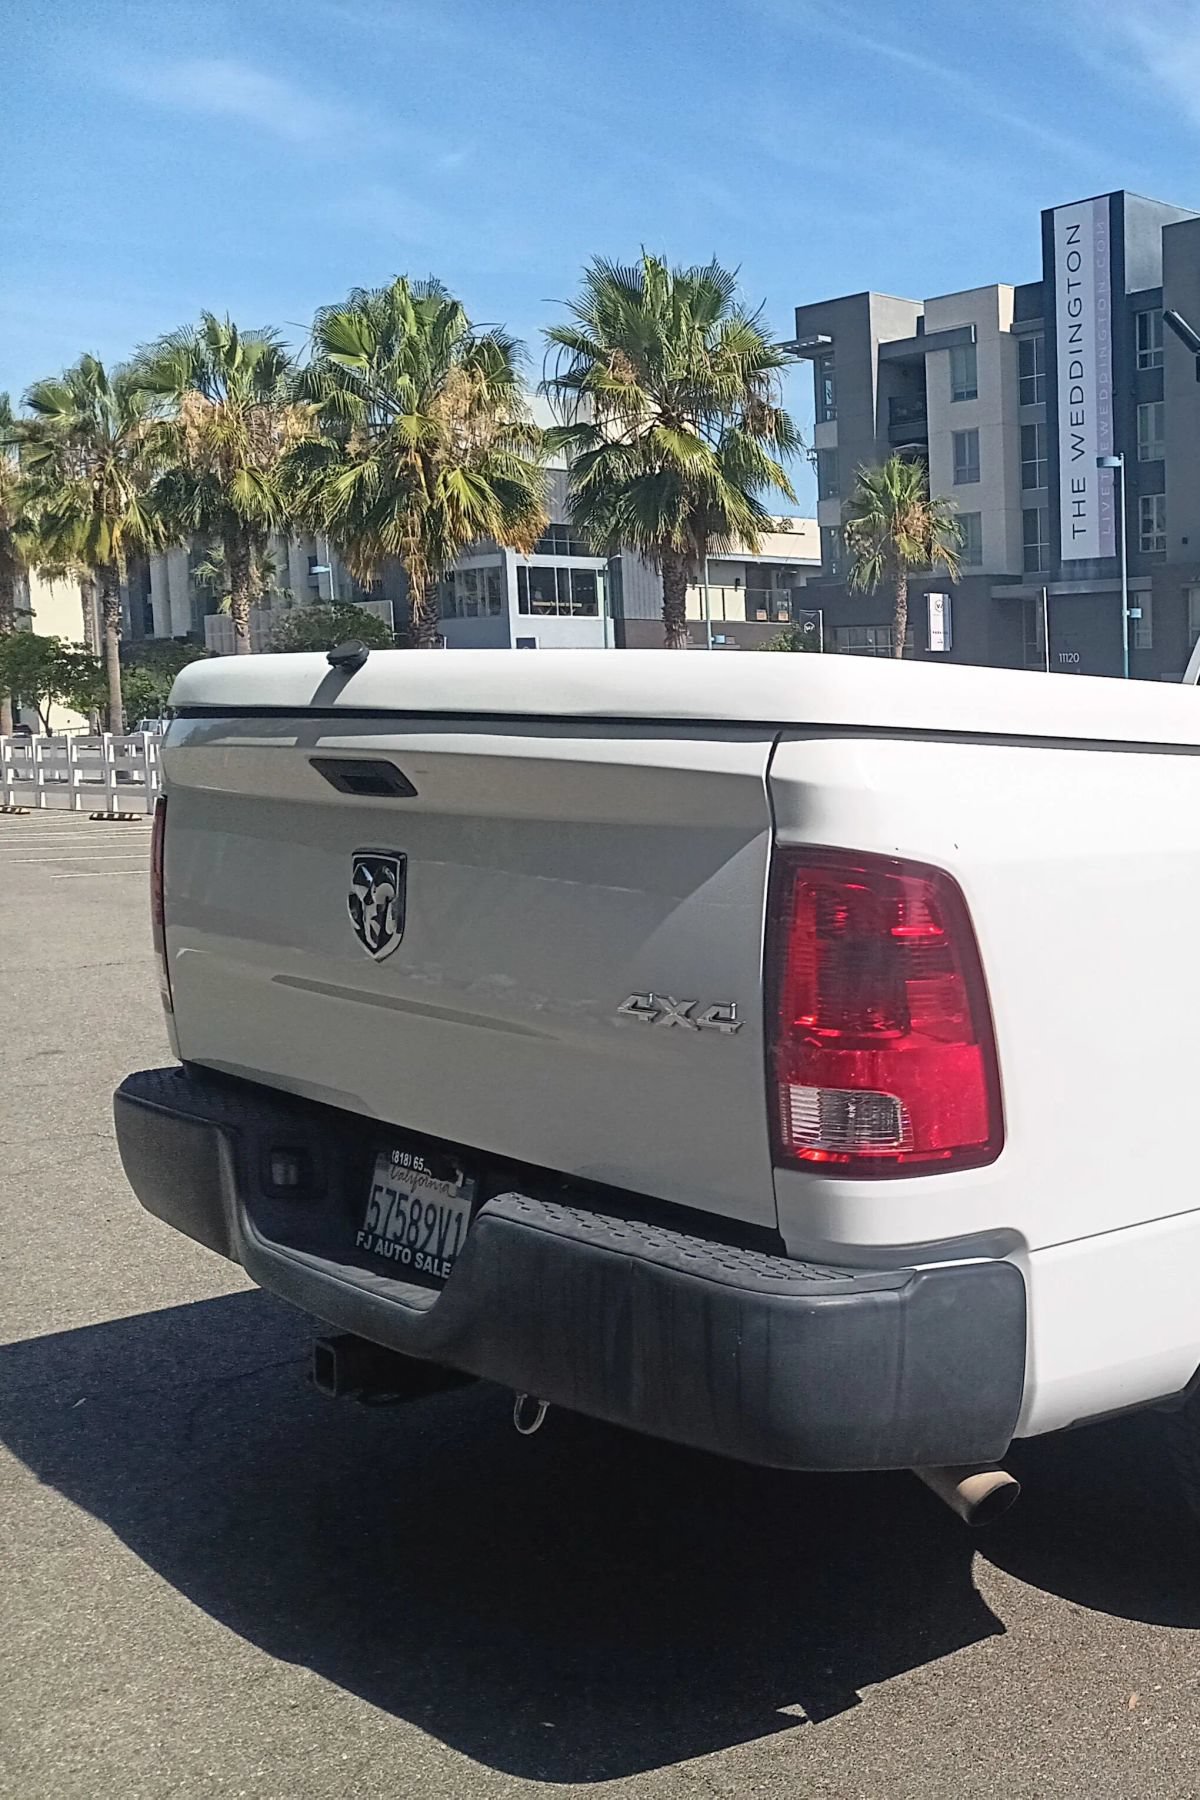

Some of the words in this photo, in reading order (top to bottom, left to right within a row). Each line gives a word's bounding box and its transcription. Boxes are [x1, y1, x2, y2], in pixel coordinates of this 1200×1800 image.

[1065, 223, 1086, 462] WEDDINGTON
[1096, 221, 1112, 536] LIVETEWEDDINGTON.COM
[1071, 476, 1087, 541] THE
[1058, 652, 1080, 664] 11120
[391, 1149, 412, 1167] (818)
[366, 1182, 465, 1260] 57589V1
[355, 1230, 373, 1250] FJ
[373, 1239, 412, 1265] AUTO
[414, 1251, 452, 1280] SALE
